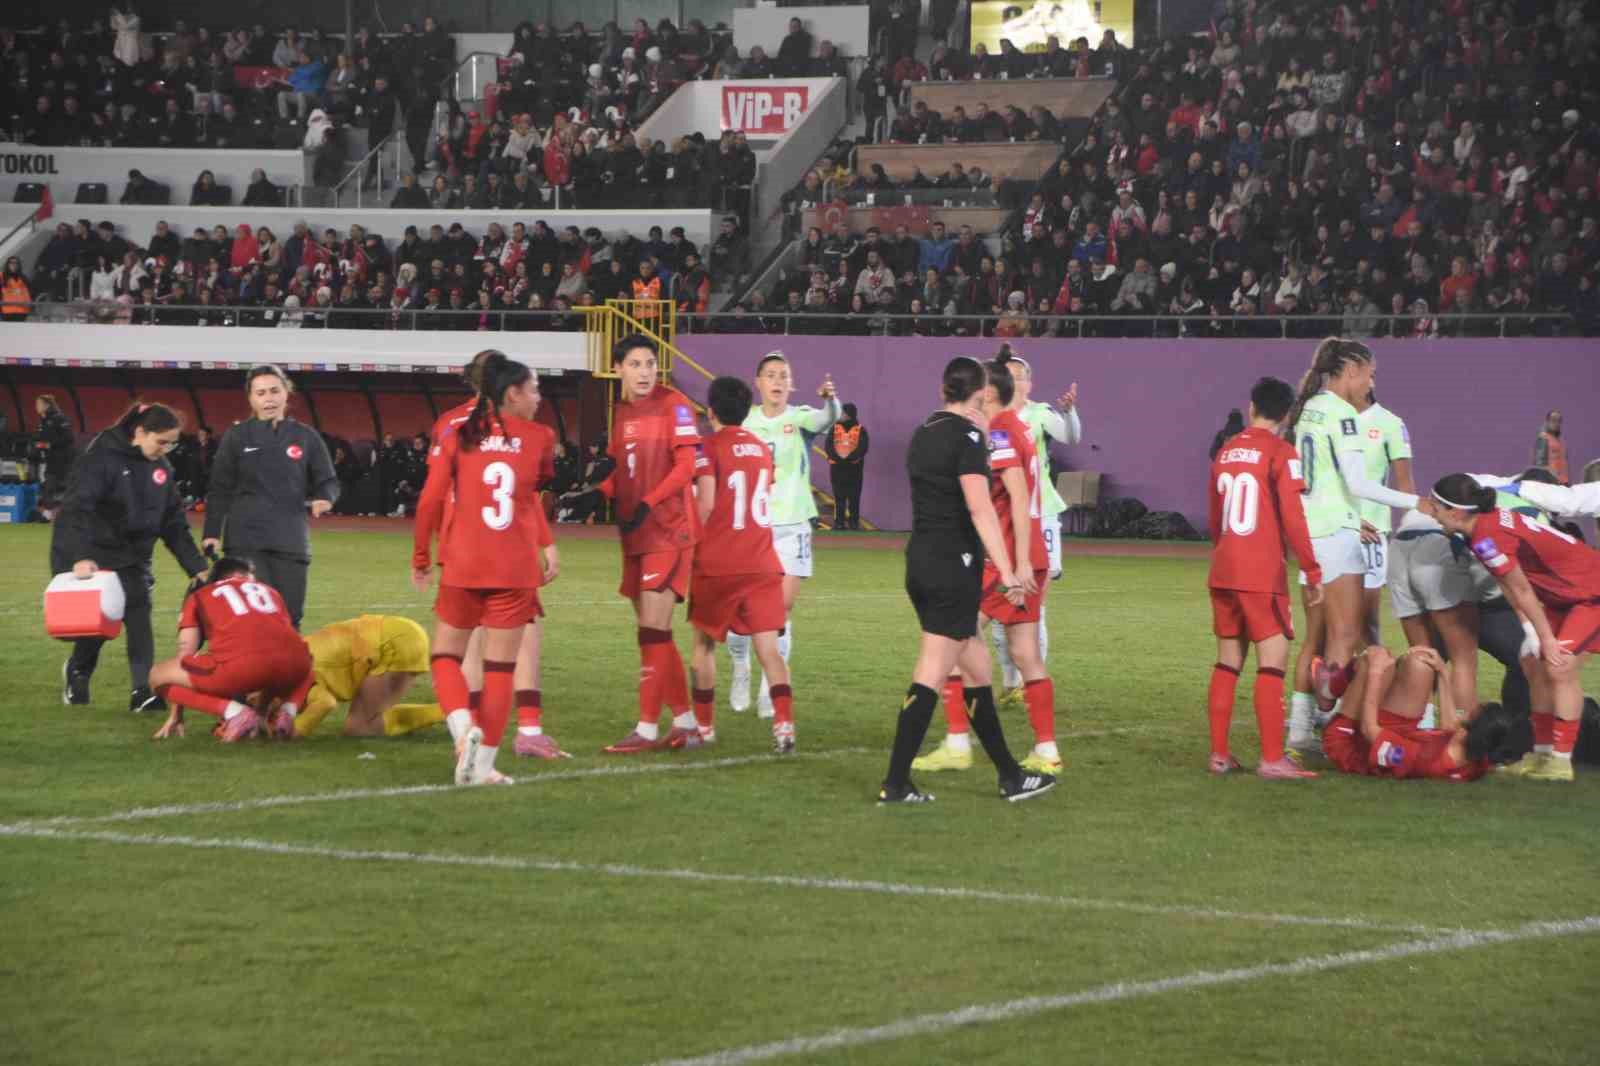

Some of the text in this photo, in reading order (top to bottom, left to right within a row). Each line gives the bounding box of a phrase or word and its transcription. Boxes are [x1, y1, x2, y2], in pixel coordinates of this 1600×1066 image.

[727, 91, 804, 130] ViP-B
[481, 461, 516, 531] 3
[728, 469, 769, 530] 16
[1217, 472, 1259, 536] 10
[212, 582, 278, 616] 18
